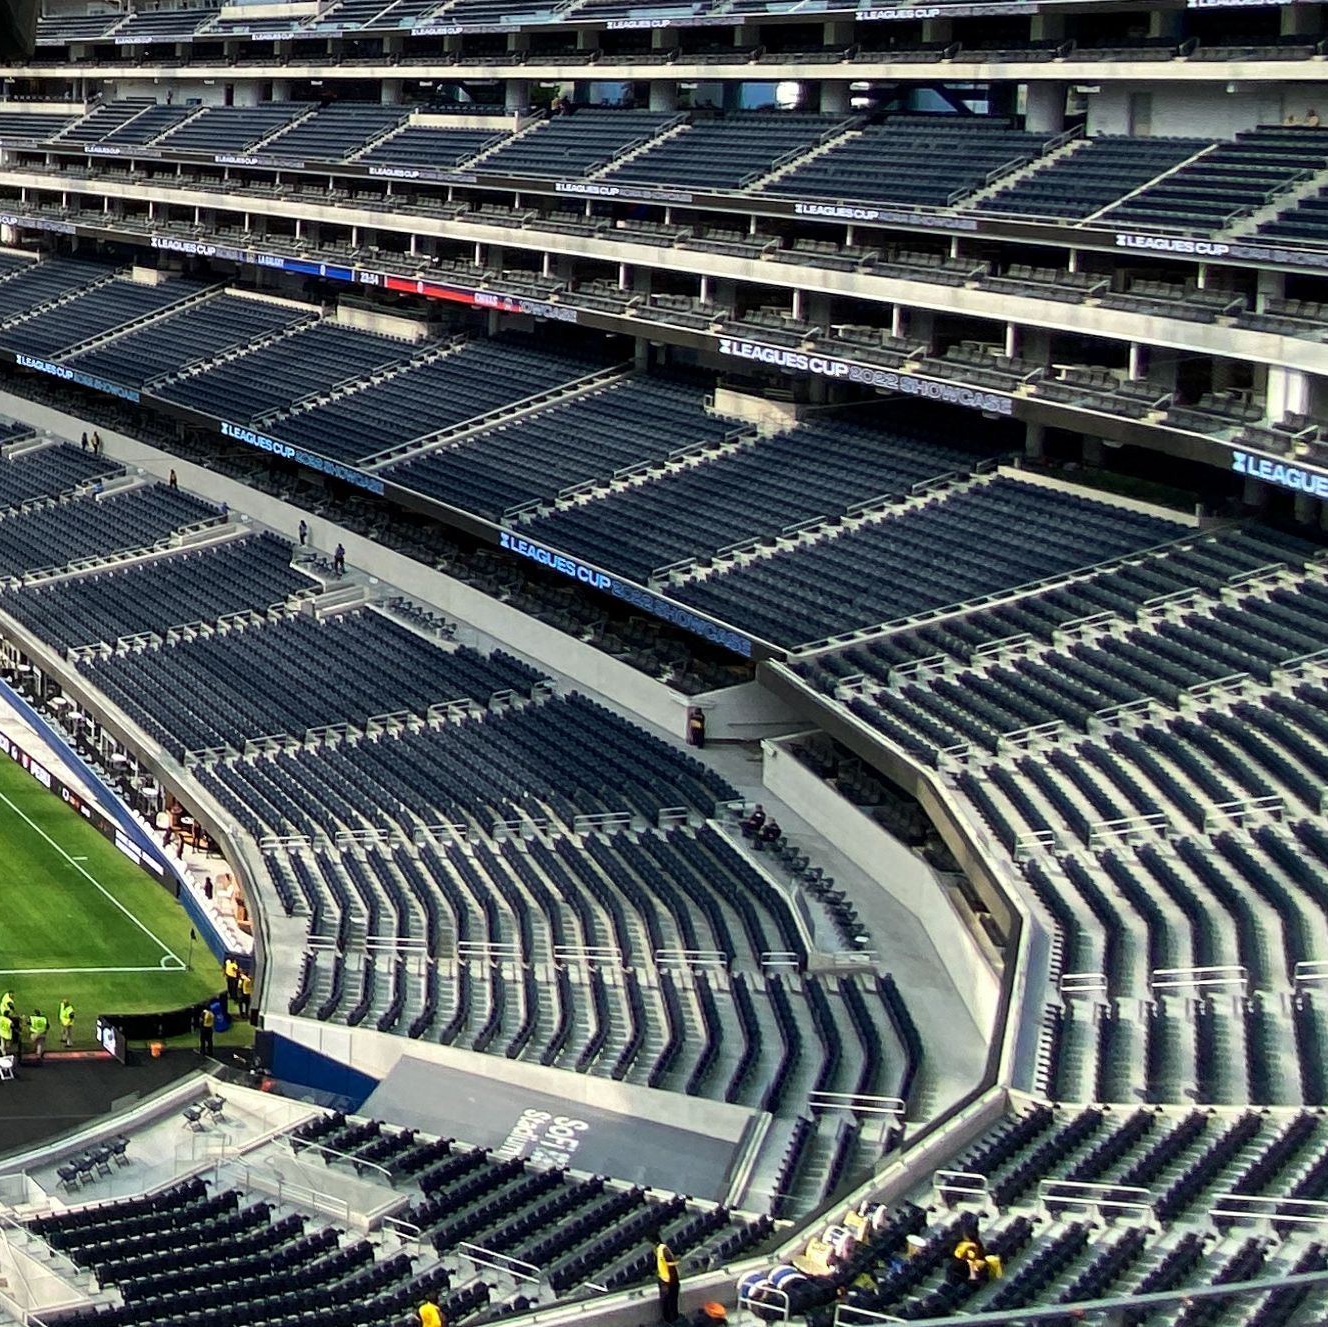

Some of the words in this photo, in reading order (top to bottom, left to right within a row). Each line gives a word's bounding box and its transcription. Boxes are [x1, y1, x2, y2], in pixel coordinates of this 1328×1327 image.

[865, 10, 914, 20] LEAGUES
[915, 9, 940, 18] CUP
[803, 204, 854, 218] LEAGUES
[854, 209, 879, 220] CUP
[158, 238, 196, 252] LEAGUES
[197, 245, 215, 256] CUP
[1127, 235, 1194, 253] LEAGUES
[1195, 242, 1229, 256] CUP
[732, 343, 809, 371] LEAGUES
[809, 356, 849, 377] CUP
[849, 366, 898, 391] 2022
[900, 378, 1012, 415] SHOWCASE
[229, 424, 273, 451] LEAGUES
[273, 442, 295, 459] CUP
[510, 535, 576, 577] LEAGUES
[576, 565, 612, 590] CUP
[498, 1108, 552, 1158] Stadium
[539, 1116, 589, 1152] SoFi
